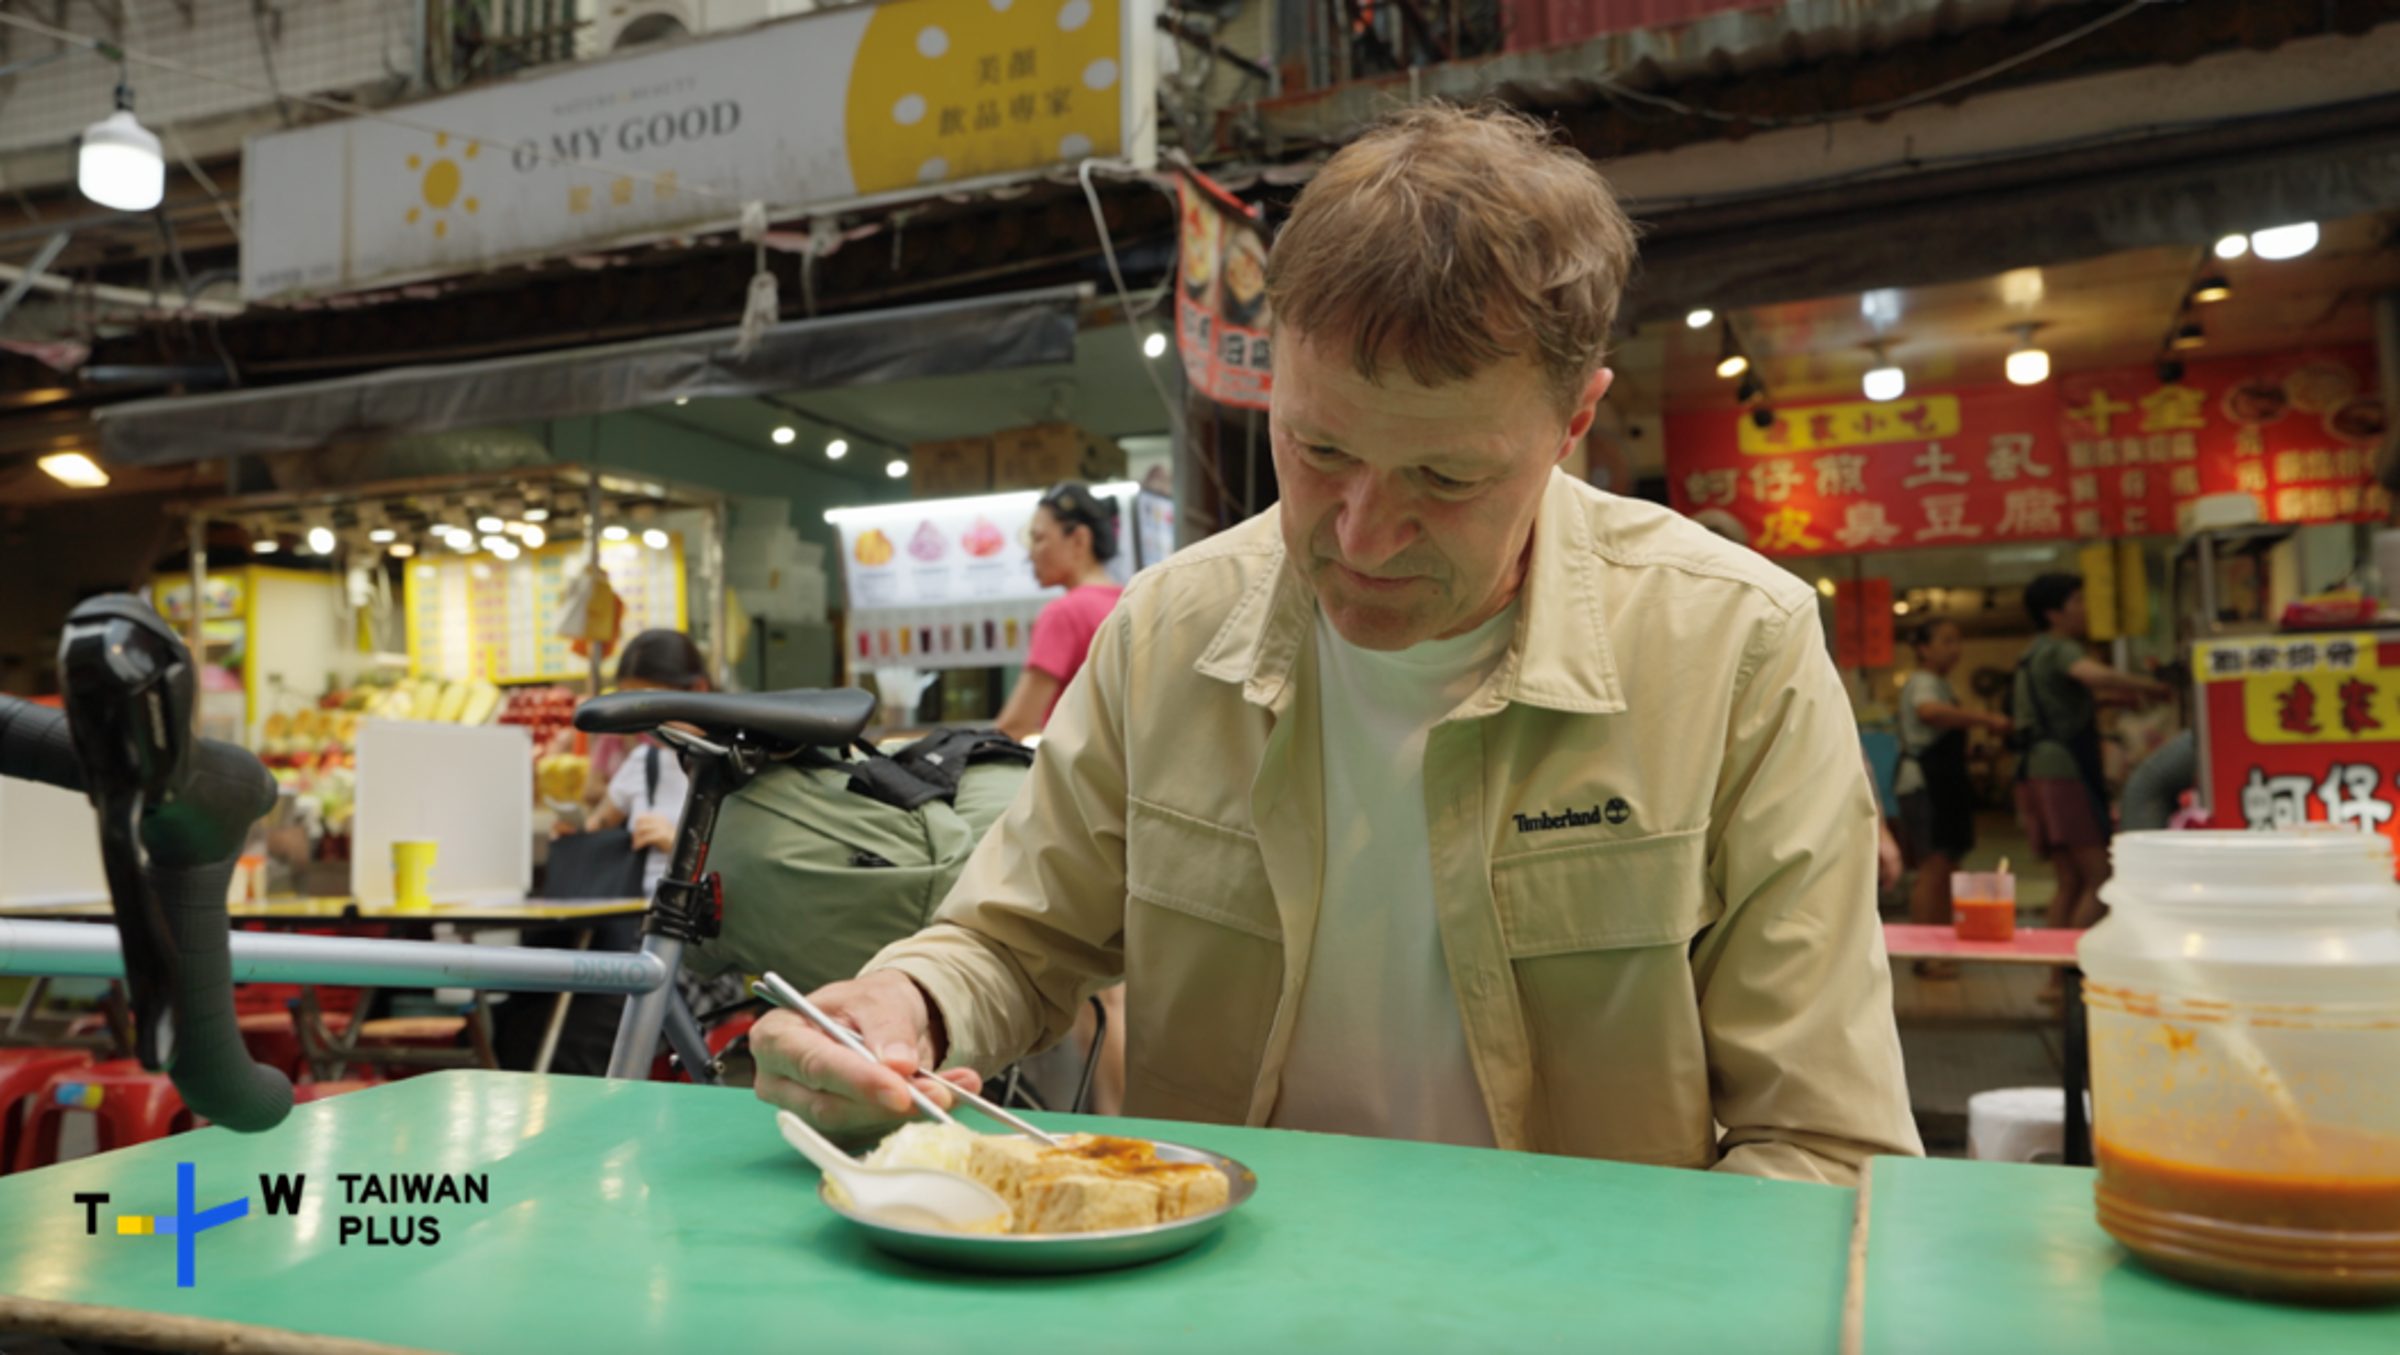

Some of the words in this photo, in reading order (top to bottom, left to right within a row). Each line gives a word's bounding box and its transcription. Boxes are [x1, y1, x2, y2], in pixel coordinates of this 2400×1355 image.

[976, 47, 1038, 87] 美顏
[937, 87, 1074, 137] 飲品專家
[512, 138, 540, 174] O
[550, 124, 608, 168] MY
[617, 98, 742, 153] GOOD
[1684, 452, 1868, 506] 蚵仔煎
[1512, 804, 1601, 833] Timberland
[573, 958, 647, 984] DISKO
